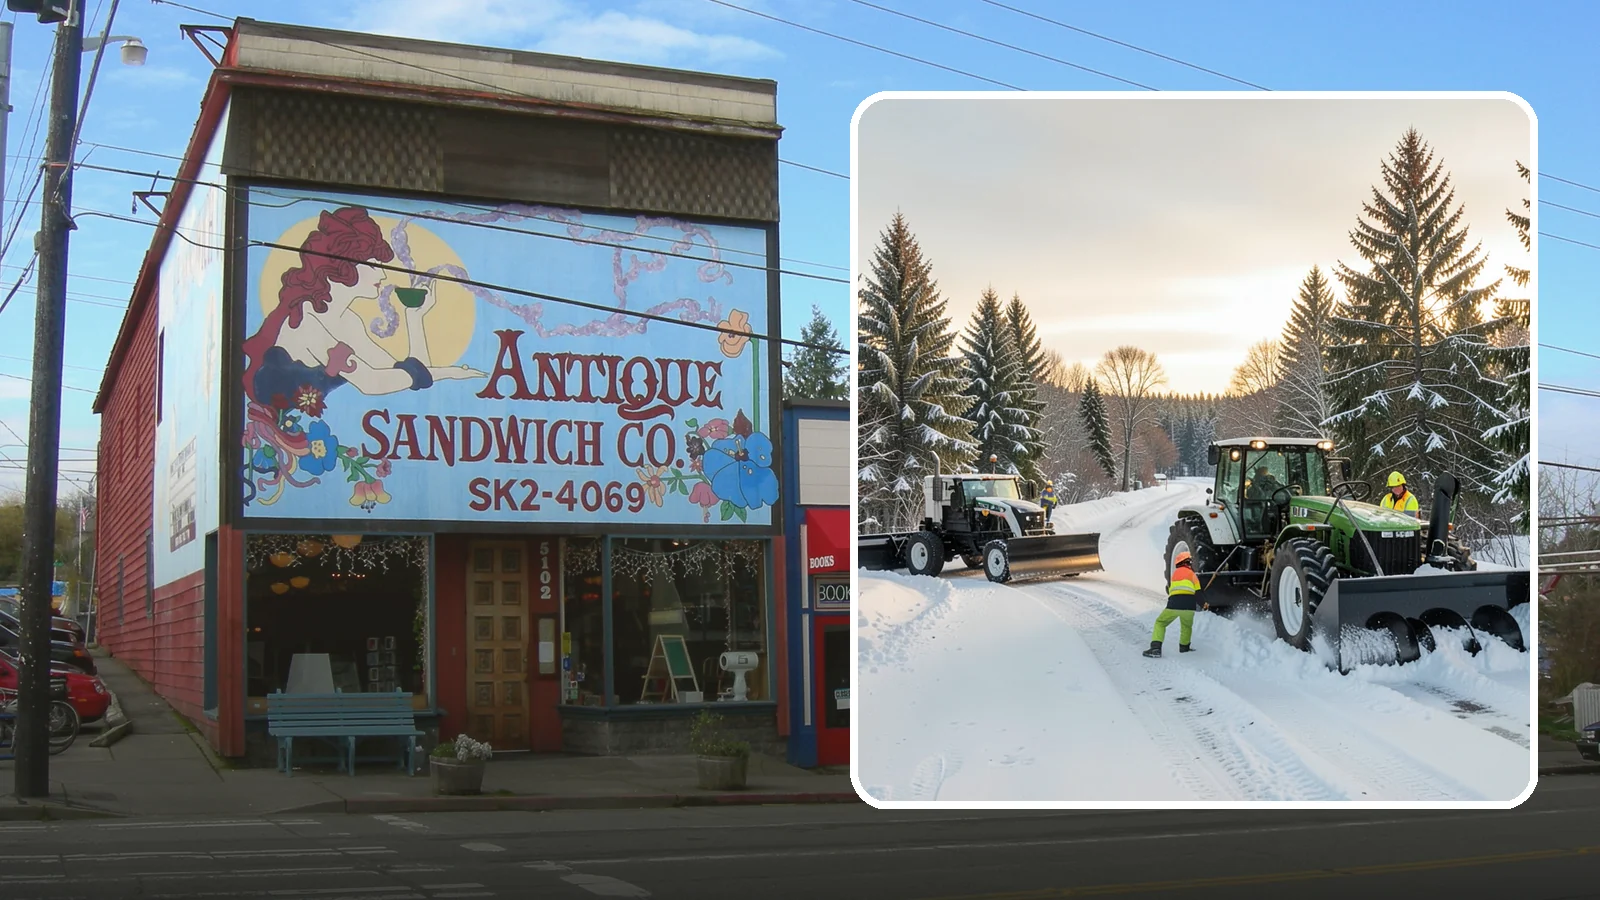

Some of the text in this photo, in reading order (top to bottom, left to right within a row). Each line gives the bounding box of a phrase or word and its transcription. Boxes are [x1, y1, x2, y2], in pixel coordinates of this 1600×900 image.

[476, 329, 724, 421] ANTIQUE
[361, 408, 685, 469] SANDWICH CO.
[468, 477, 646, 513] SK2-4069
[540, 541, 551, 600] 5102
[809, 555, 835, 569] BOOKS
